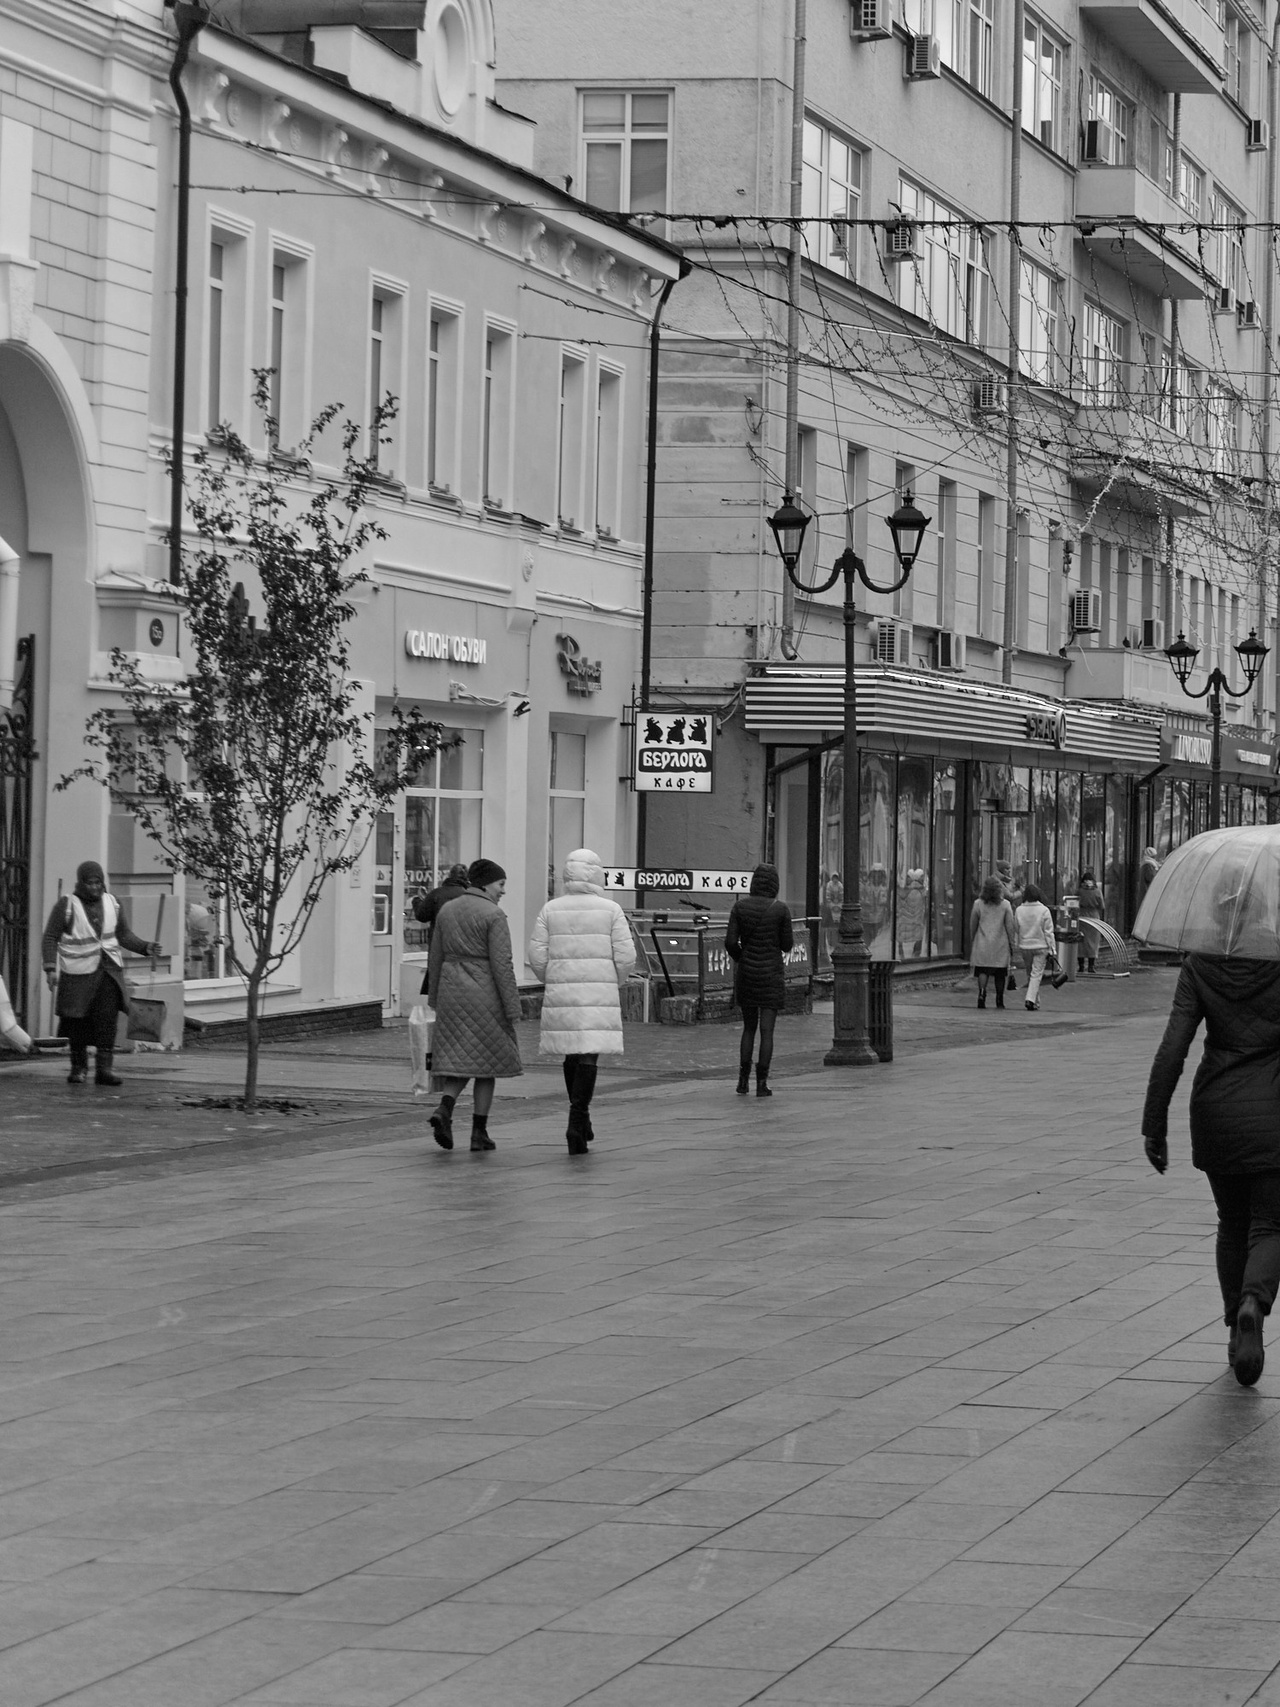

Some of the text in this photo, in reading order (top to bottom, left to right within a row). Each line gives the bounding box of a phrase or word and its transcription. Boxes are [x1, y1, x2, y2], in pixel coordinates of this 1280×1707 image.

[406, 630, 486, 664] САЛОН ОБУВИ
[1028, 713, 1057, 740] SPAR
[642, 751, 707, 769] БЕРЛОГА
[654, 777, 696, 790] КАФЕ
[637, 873, 748, 890] БЕРЛОГА КАФЕ
